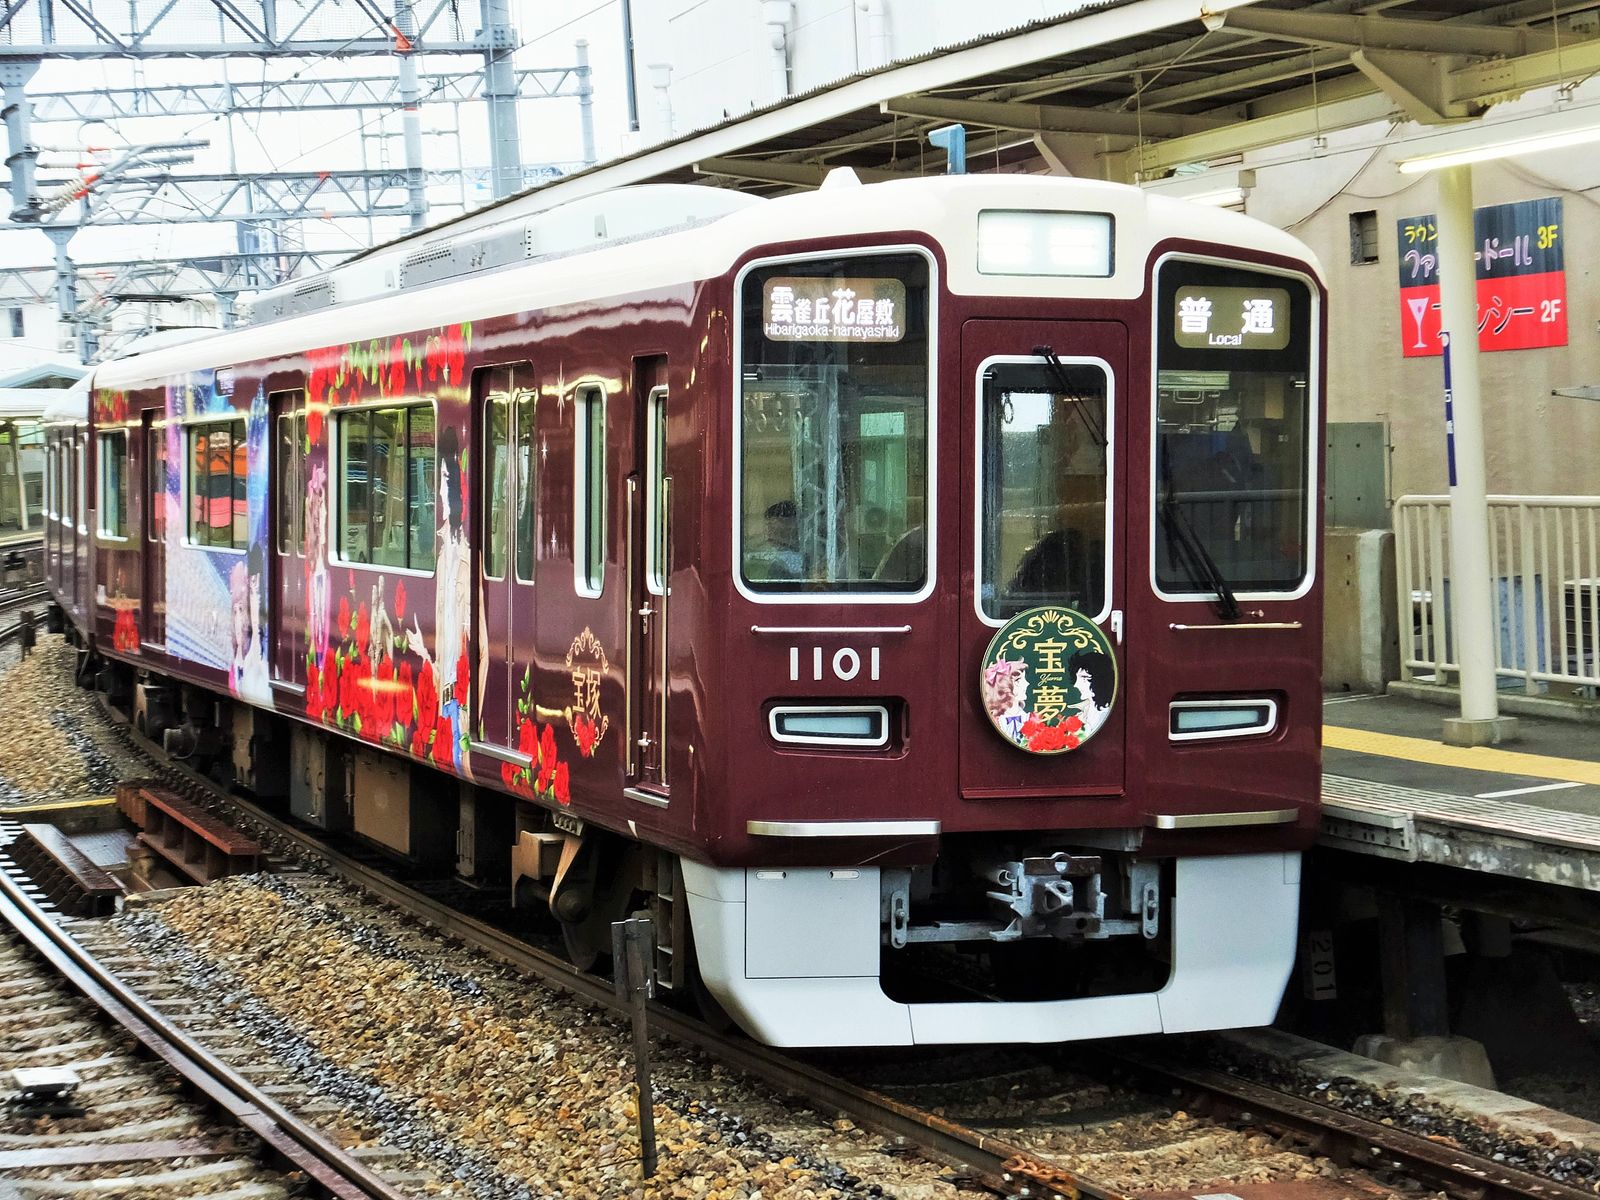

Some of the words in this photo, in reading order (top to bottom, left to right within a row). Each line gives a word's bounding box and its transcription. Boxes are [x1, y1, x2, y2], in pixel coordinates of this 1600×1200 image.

[1537, 224, 1559, 250] 3F
[770, 286, 895, 325] 雲雀丘花屋敷
[1540, 298, 1562, 323] 2F
[765, 323, 899, 340] Hibarigaoka-hanayashiki
[1208, 333, 1243, 346] Local
[789, 647, 880, 681] 1101
[571, 667, 601, 719] 宝塚
[1311, 939, 1335, 992] 201
